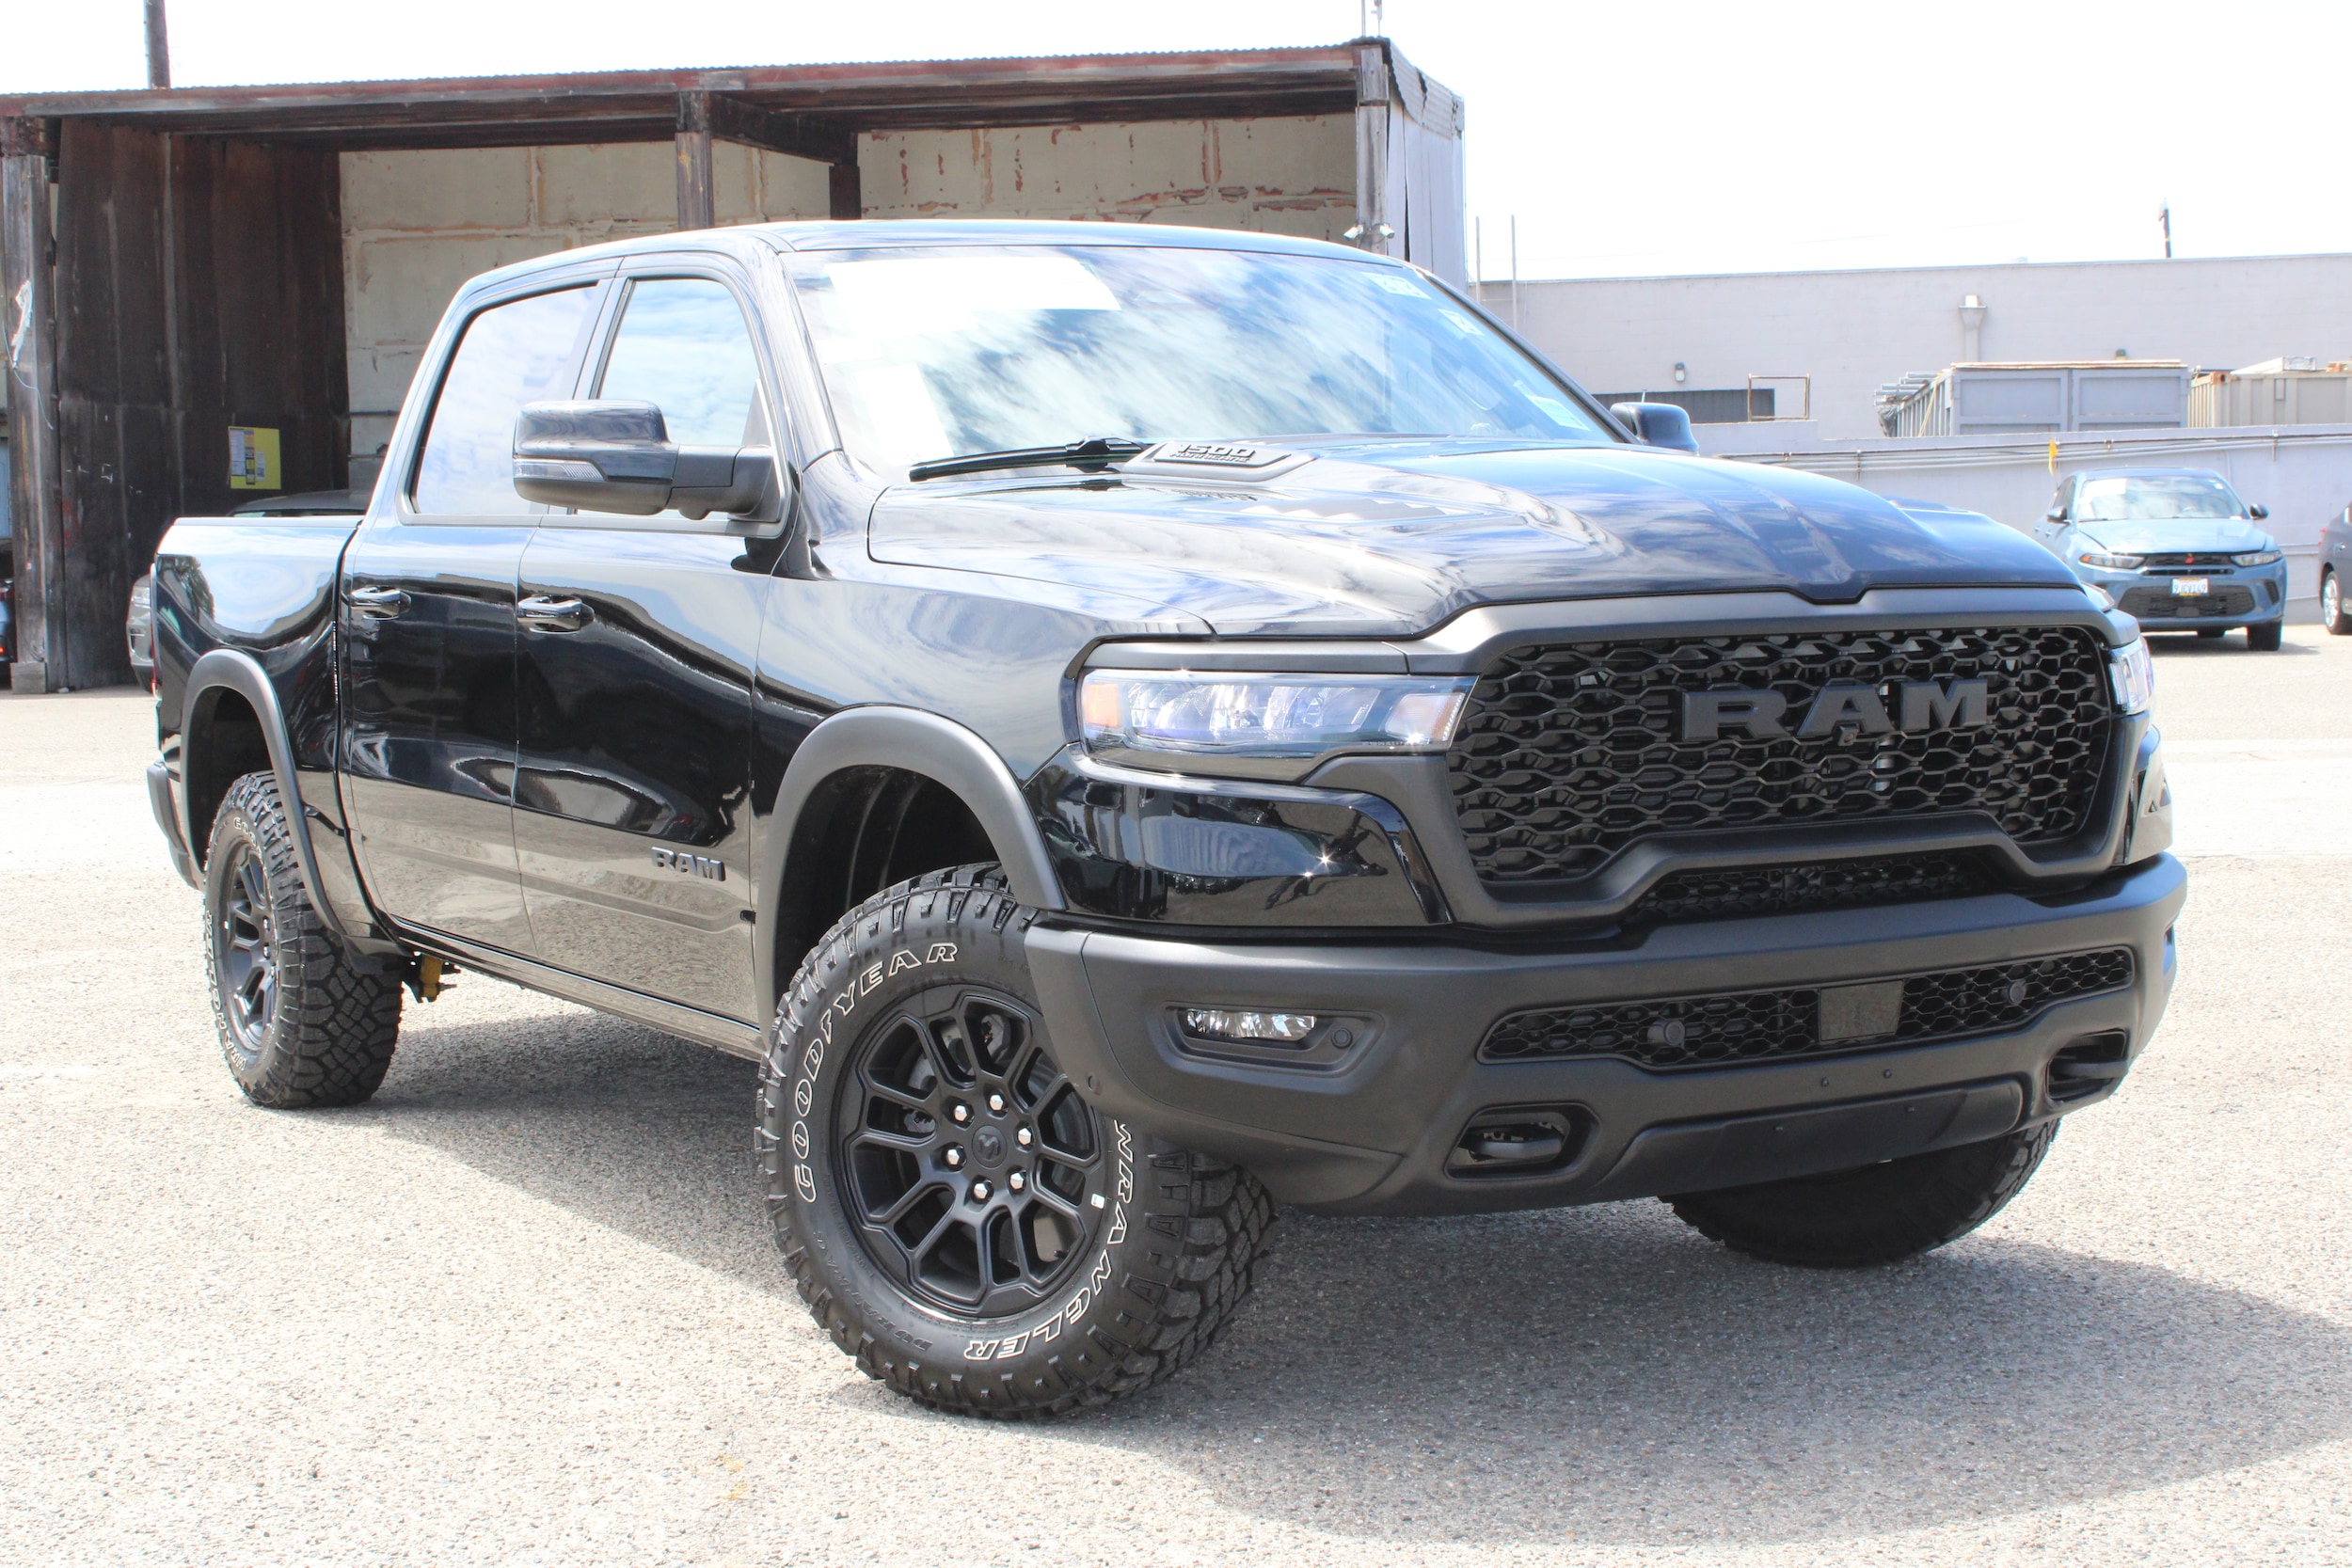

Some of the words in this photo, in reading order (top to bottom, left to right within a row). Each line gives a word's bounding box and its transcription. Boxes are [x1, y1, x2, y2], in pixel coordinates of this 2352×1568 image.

[1178, 443, 1257, 458] 1500
[1682, 678, 1988, 742] RAM
[651, 847, 726, 881] RAM
[791, 942, 959, 1204] GOODYEAR
